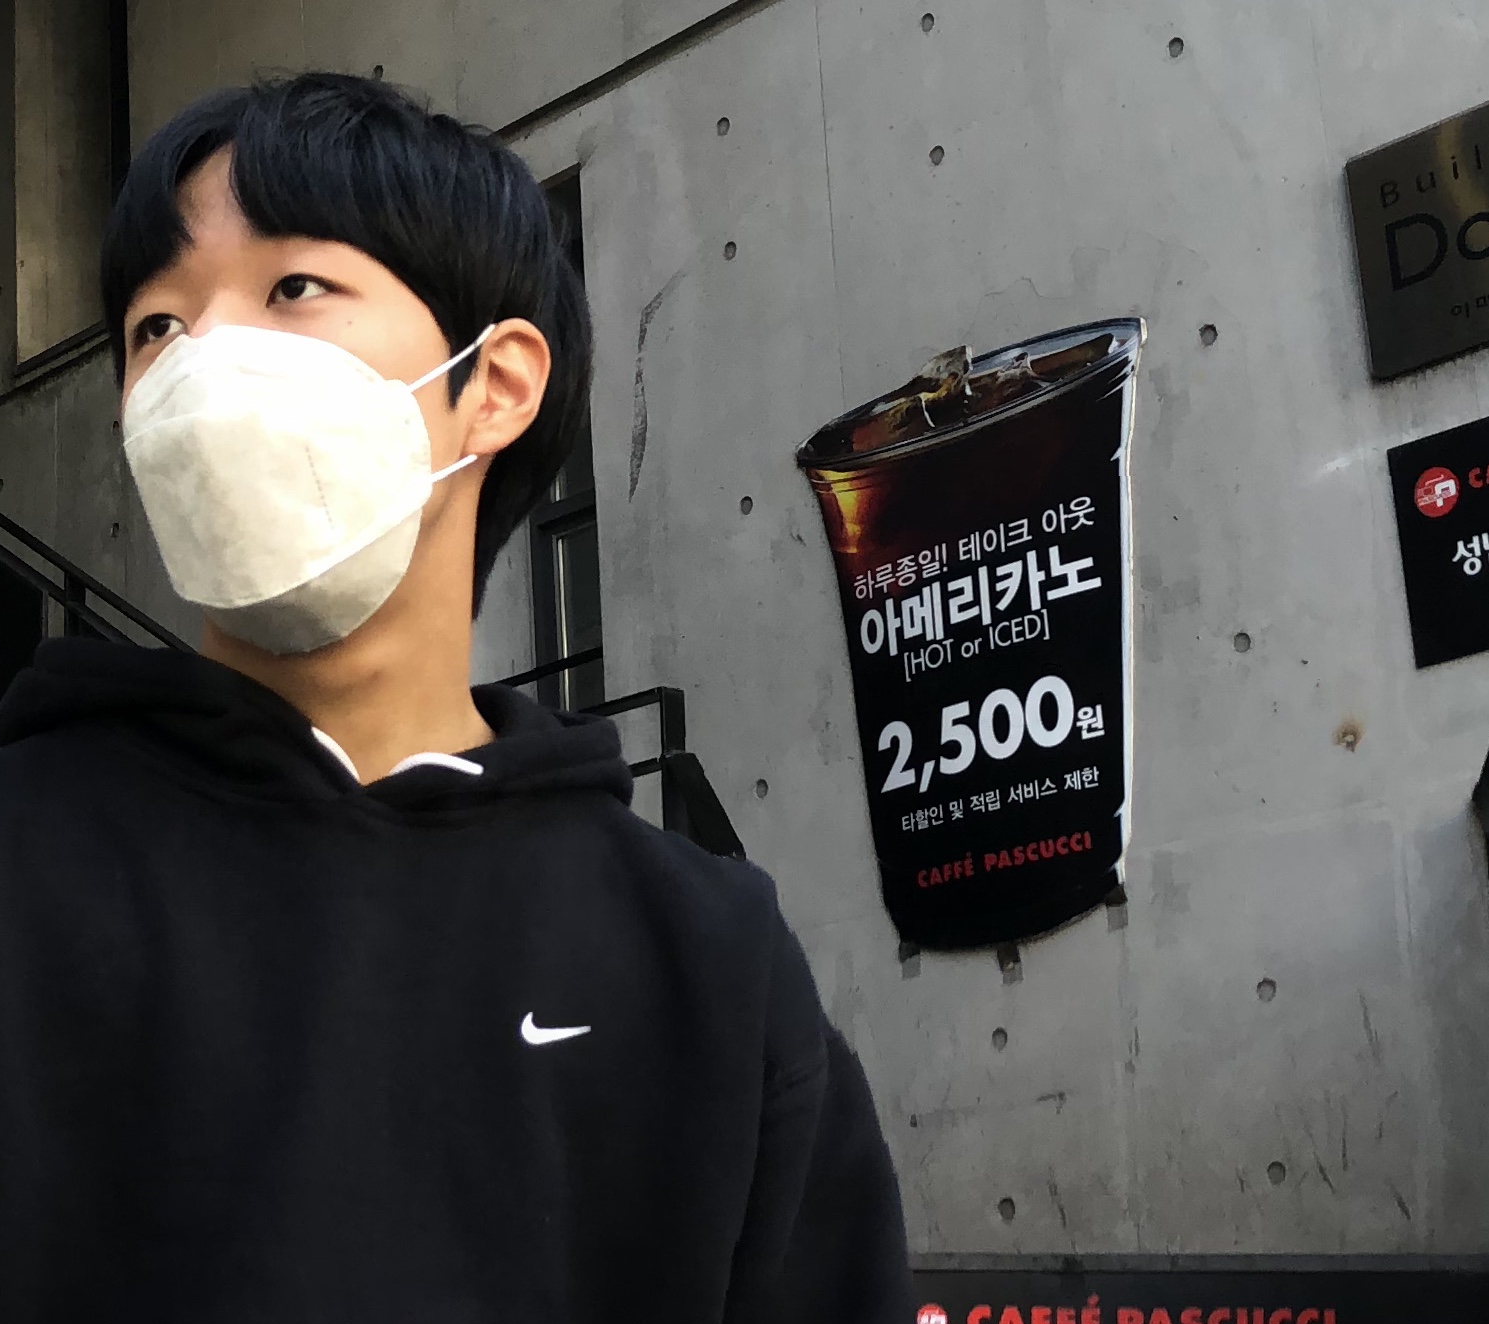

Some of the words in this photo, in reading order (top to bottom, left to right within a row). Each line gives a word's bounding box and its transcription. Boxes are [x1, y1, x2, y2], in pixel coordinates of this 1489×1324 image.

[1379, 144, 1483, 208] Buil
[853, 543, 949, 600] 하루종일!
[958, 518, 1033, 562] 테이크
[1041, 496, 1096, 534] 아웃
[860, 545, 1103, 657] 아메리카노
[961, 637, 983, 658] or
[901, 804, 944, 833] 타할인
[949, 798, 964, 821] 및
[969, 788, 1001, 814] 적립
[1007, 778, 1058, 805] 서비스
[1063, 766, 1100, 792] 제한
[916, 851, 975, 888] CAFFÉ
[983, 830, 1093, 872] PASCUCCI
